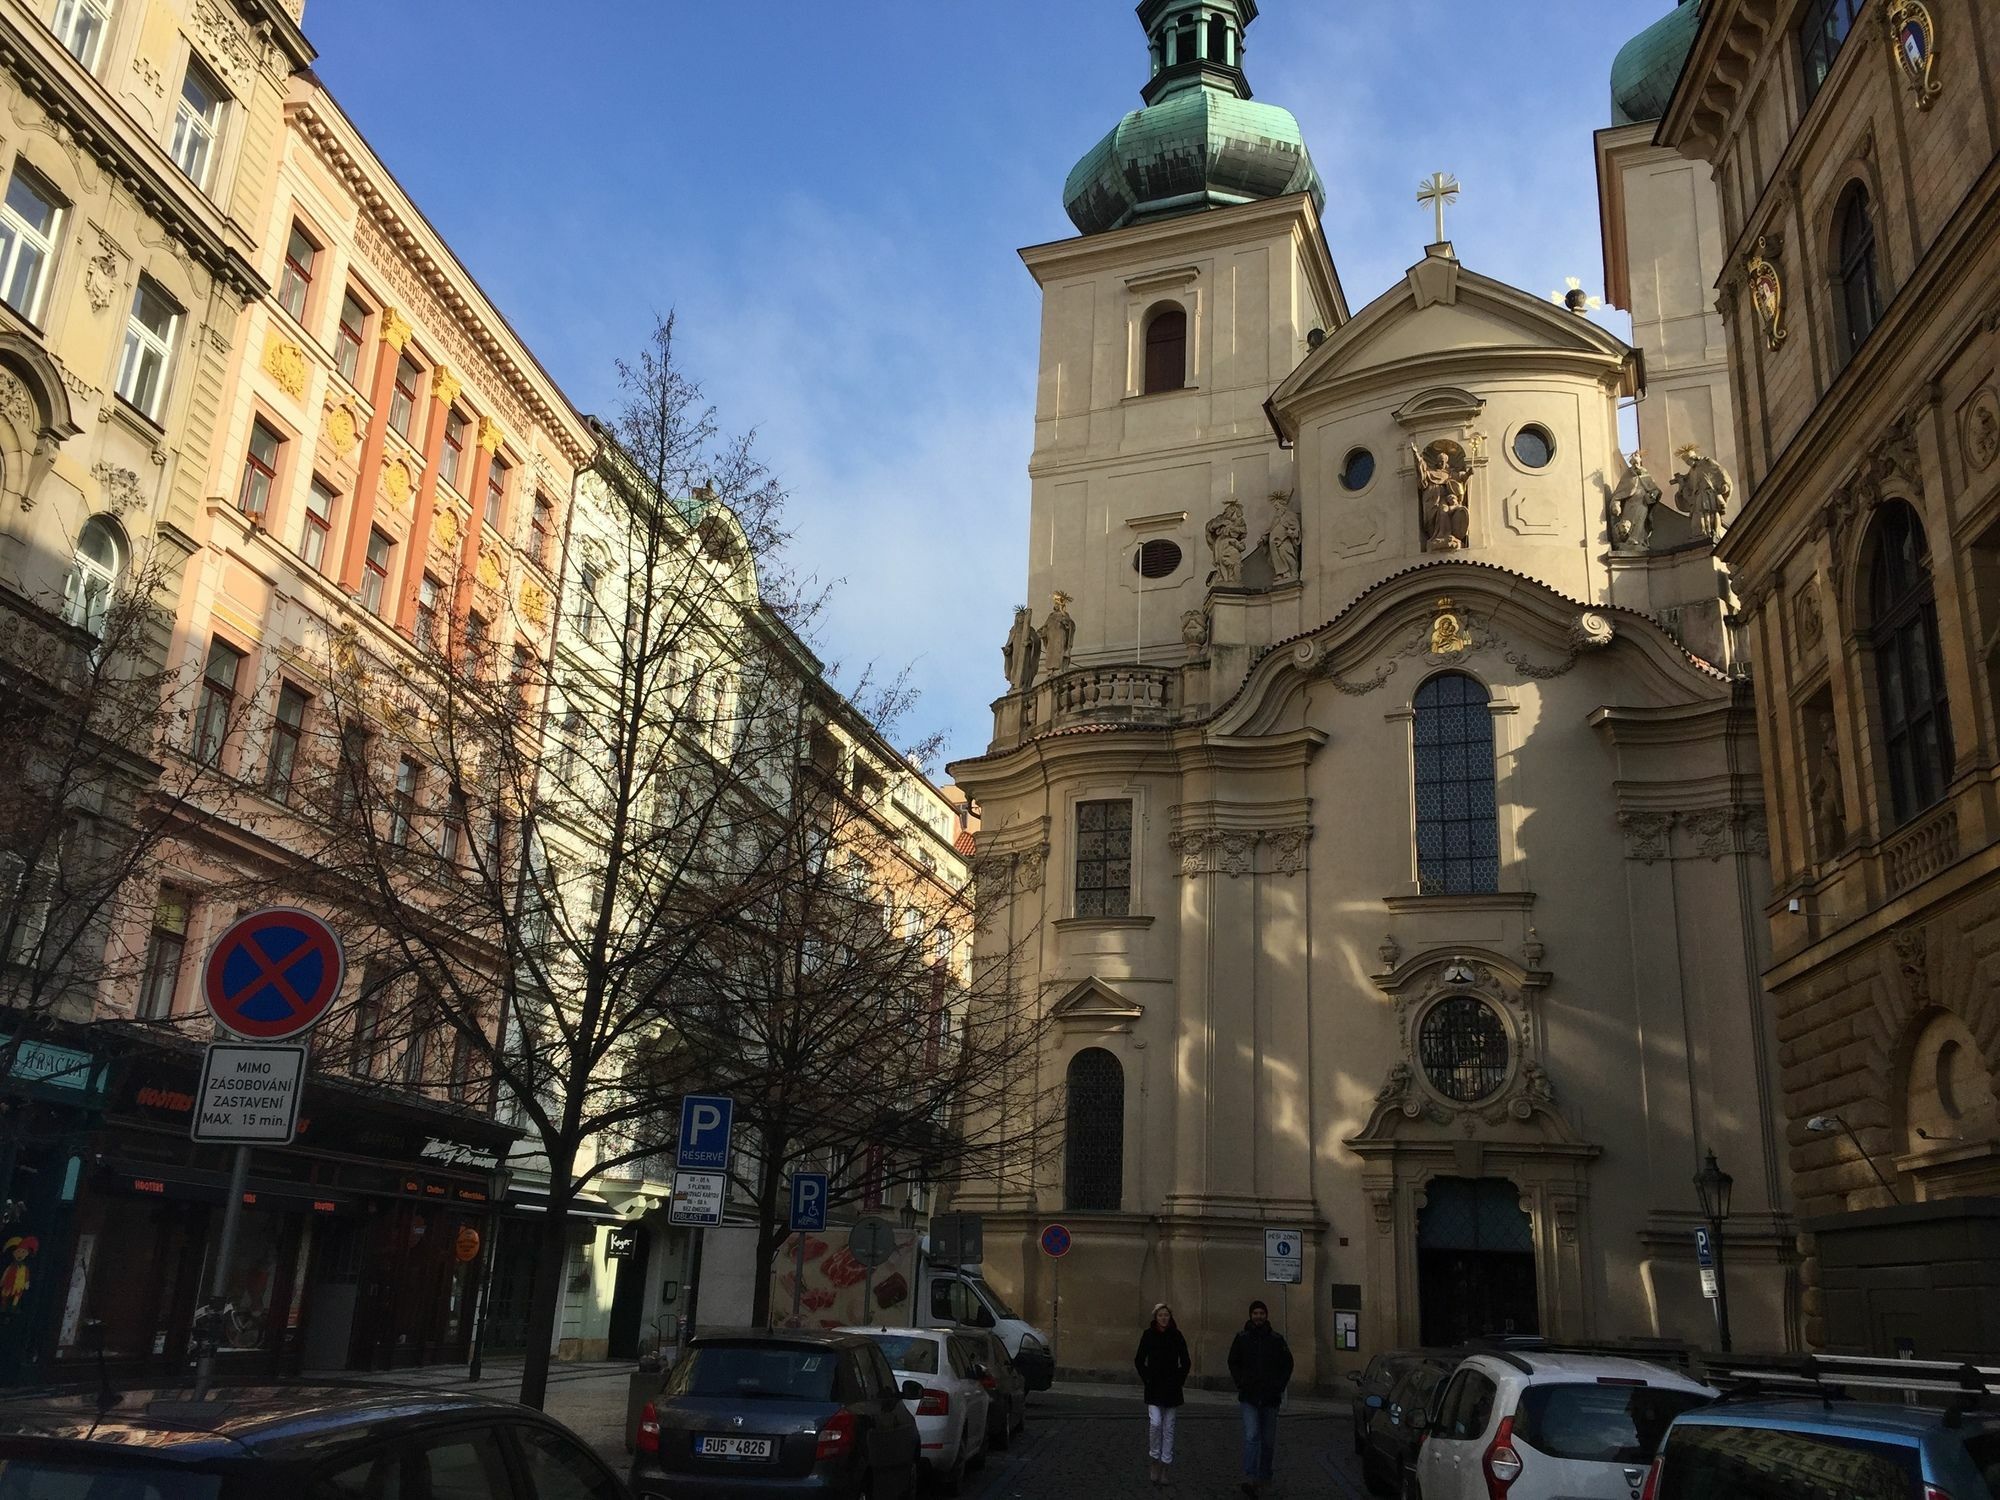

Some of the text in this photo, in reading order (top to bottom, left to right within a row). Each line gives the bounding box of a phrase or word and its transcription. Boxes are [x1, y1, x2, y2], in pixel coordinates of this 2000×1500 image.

[370, 251, 380, 270] NA
[236, 1062, 271, 1074] MIMO
[210, 1076, 294, 1092] ZÁSOBOVÁNÍ
[213, 1095, 285, 1109] ZASTAVENÍ
[202, 1113, 232, 1125] MAX.
[242, 1114, 256, 1125] 15
[259, 1114, 287, 1126] min.
[690, 1104, 721, 1146] P
[133, 1179, 165, 1193] HOOTERS
[799, 1180, 819, 1213] P
[675, 1212, 702, 1221] OBLAST
[705, 1439, 727, 1452] 5U5
[736, 1441, 765, 1455] 4826
